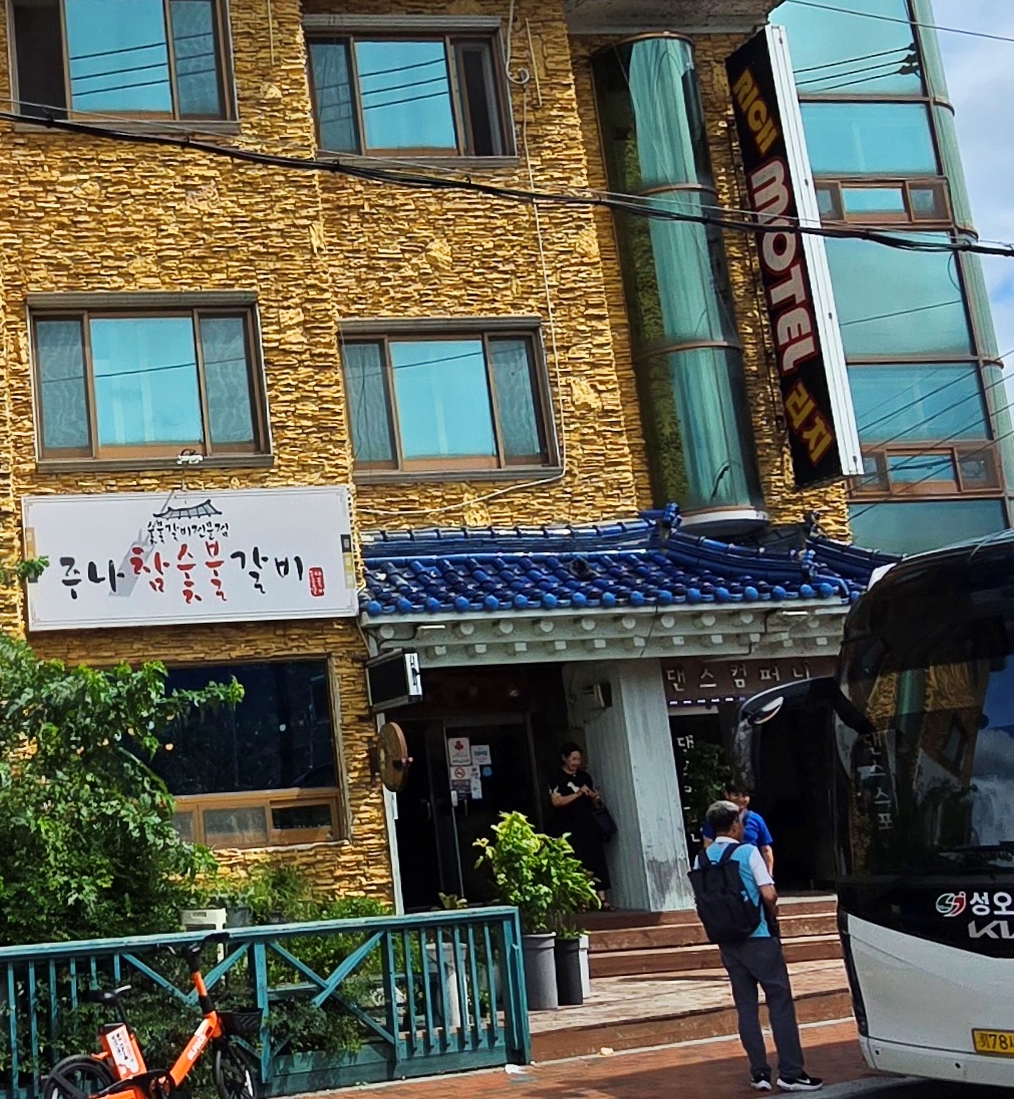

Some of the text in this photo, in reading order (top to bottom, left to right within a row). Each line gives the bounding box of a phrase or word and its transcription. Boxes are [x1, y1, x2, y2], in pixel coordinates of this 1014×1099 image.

[733, 68, 778, 154] RICH
[751, 159, 817, 371] MOTEL
[666, 661, 810, 692] 댄스컴퍼니
[967, 920, 1014, 939] KI
